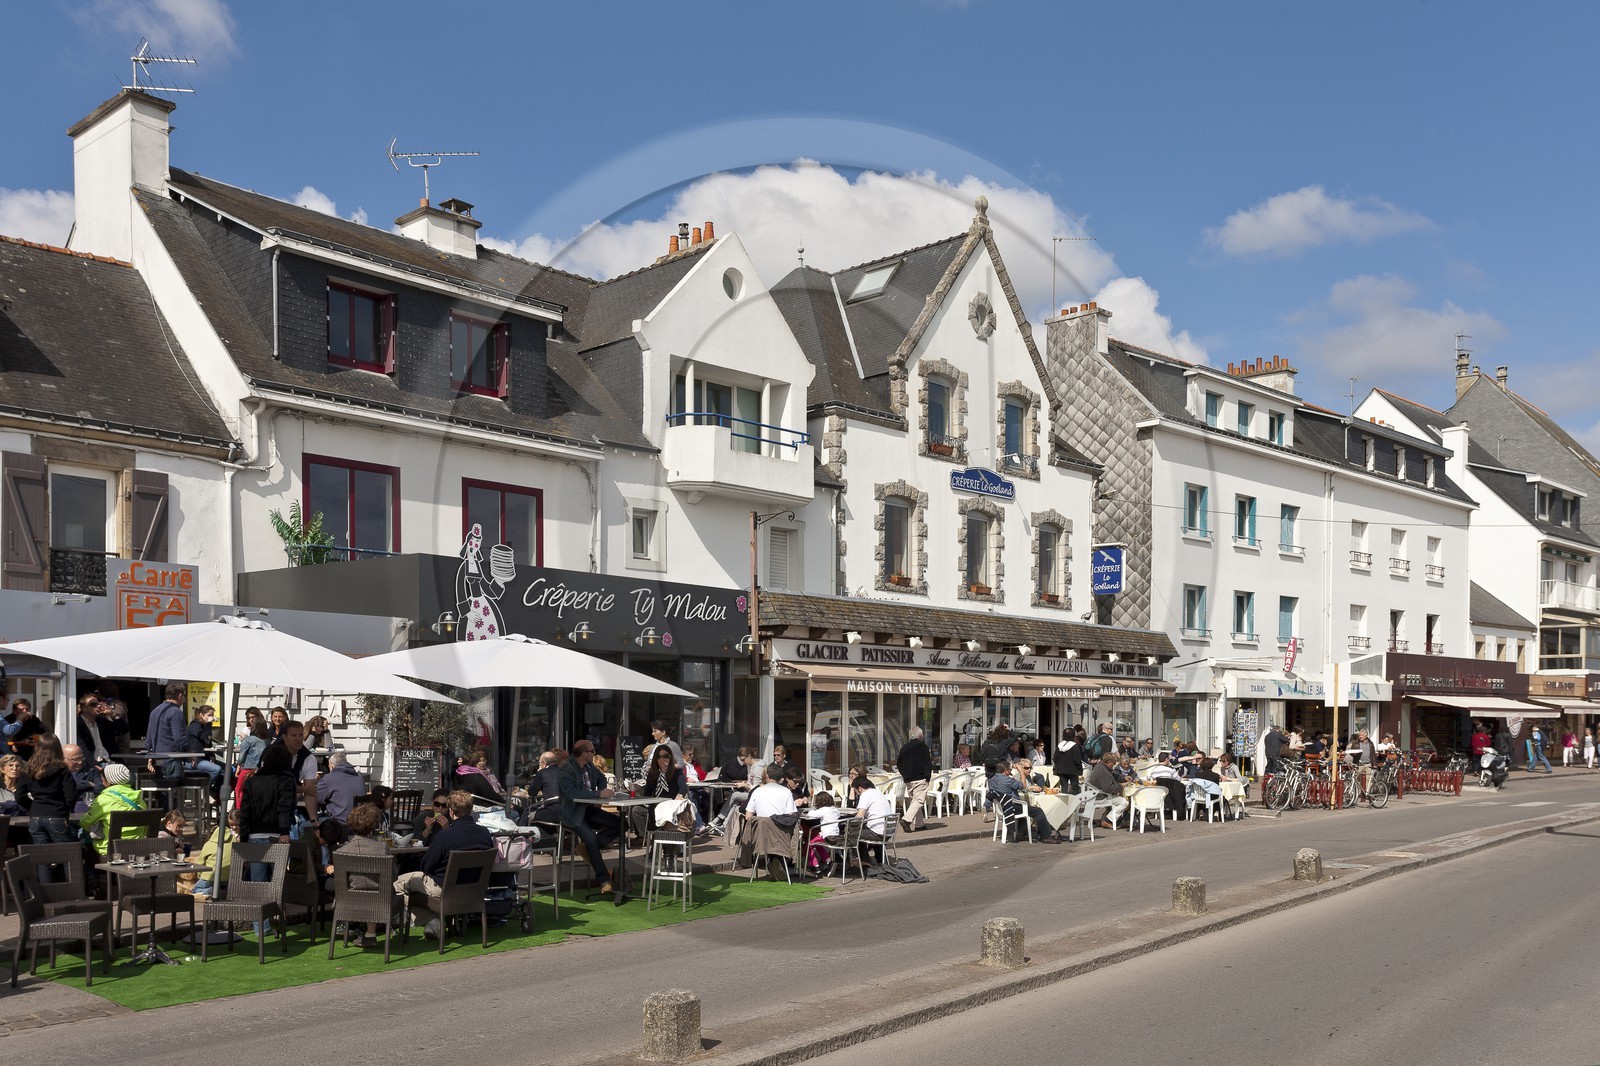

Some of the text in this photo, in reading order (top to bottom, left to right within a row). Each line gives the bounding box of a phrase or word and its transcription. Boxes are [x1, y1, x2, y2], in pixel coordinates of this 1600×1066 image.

[982, 480, 989, 491] Le
[125, 594, 184, 610] FRA
[522, 578, 727, 625] Crêperie Ty Malou
[797, 643, 915, 664] GLACIER PATISSIER
[1284, 638, 1295, 671] TABAC
[927, 650, 950, 667] Aux
[997, 656, 1009, 669] du
[1014, 656, 1036, 671] Quai
[1047, 660, 1089, 673] PIZZERIA
[1101, 662, 1124, 675] SALON
[1126, 665, 1135, 675] DE
[847, 680, 960, 694] MAISON CHEVILLARD
[995, 686, 1013, 696] BAR
[1042, 687, 1098, 698] SALON DE THE
[1127, 687, 1166, 697] CHEVILLARD
[1307, 686, 1313, 695] LE
